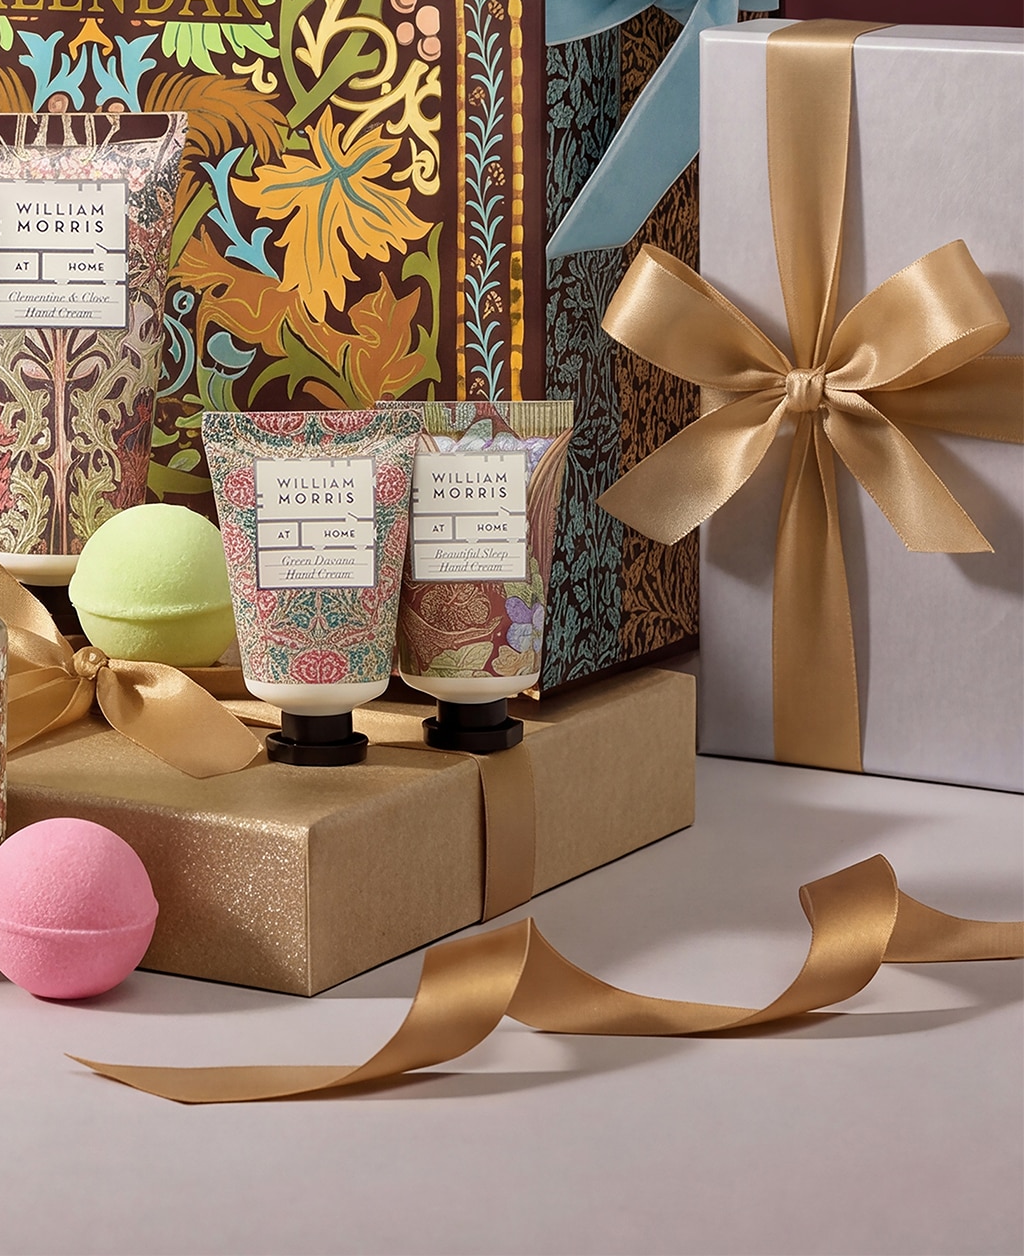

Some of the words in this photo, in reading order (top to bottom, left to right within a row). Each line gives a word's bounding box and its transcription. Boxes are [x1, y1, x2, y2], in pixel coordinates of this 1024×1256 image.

[16, 203, 104, 215] WILLIAM
[17, 220, 104, 233] MORRIS
[15, 262, 29, 271] AT
[69, 263, 104, 271] HOME
[8, 291, 65, 303] Clementine
[69, 293, 78, 302] &
[81, 293, 110, 303] Clove
[25, 307, 54, 318] Hand
[58, 307, 93, 318] Cream
[277, 478, 354, 488] WILLIAM
[432, 473, 507, 483] WILLIAM
[279, 492, 354, 504] MORRIS
[434, 487, 507, 498] MORRIS
[432, 524, 444, 532] AT
[435, 548, 480, 561] Beautiful
[482, 549, 508, 561] Sleep
[282, 556, 311, 566] Green
[316, 556, 354, 565] Davana
[439, 563, 468, 572] Hand
[471, 563, 502, 572] Cream
[285, 570, 315, 580] Hand
[318, 569, 351, 579] Cream
